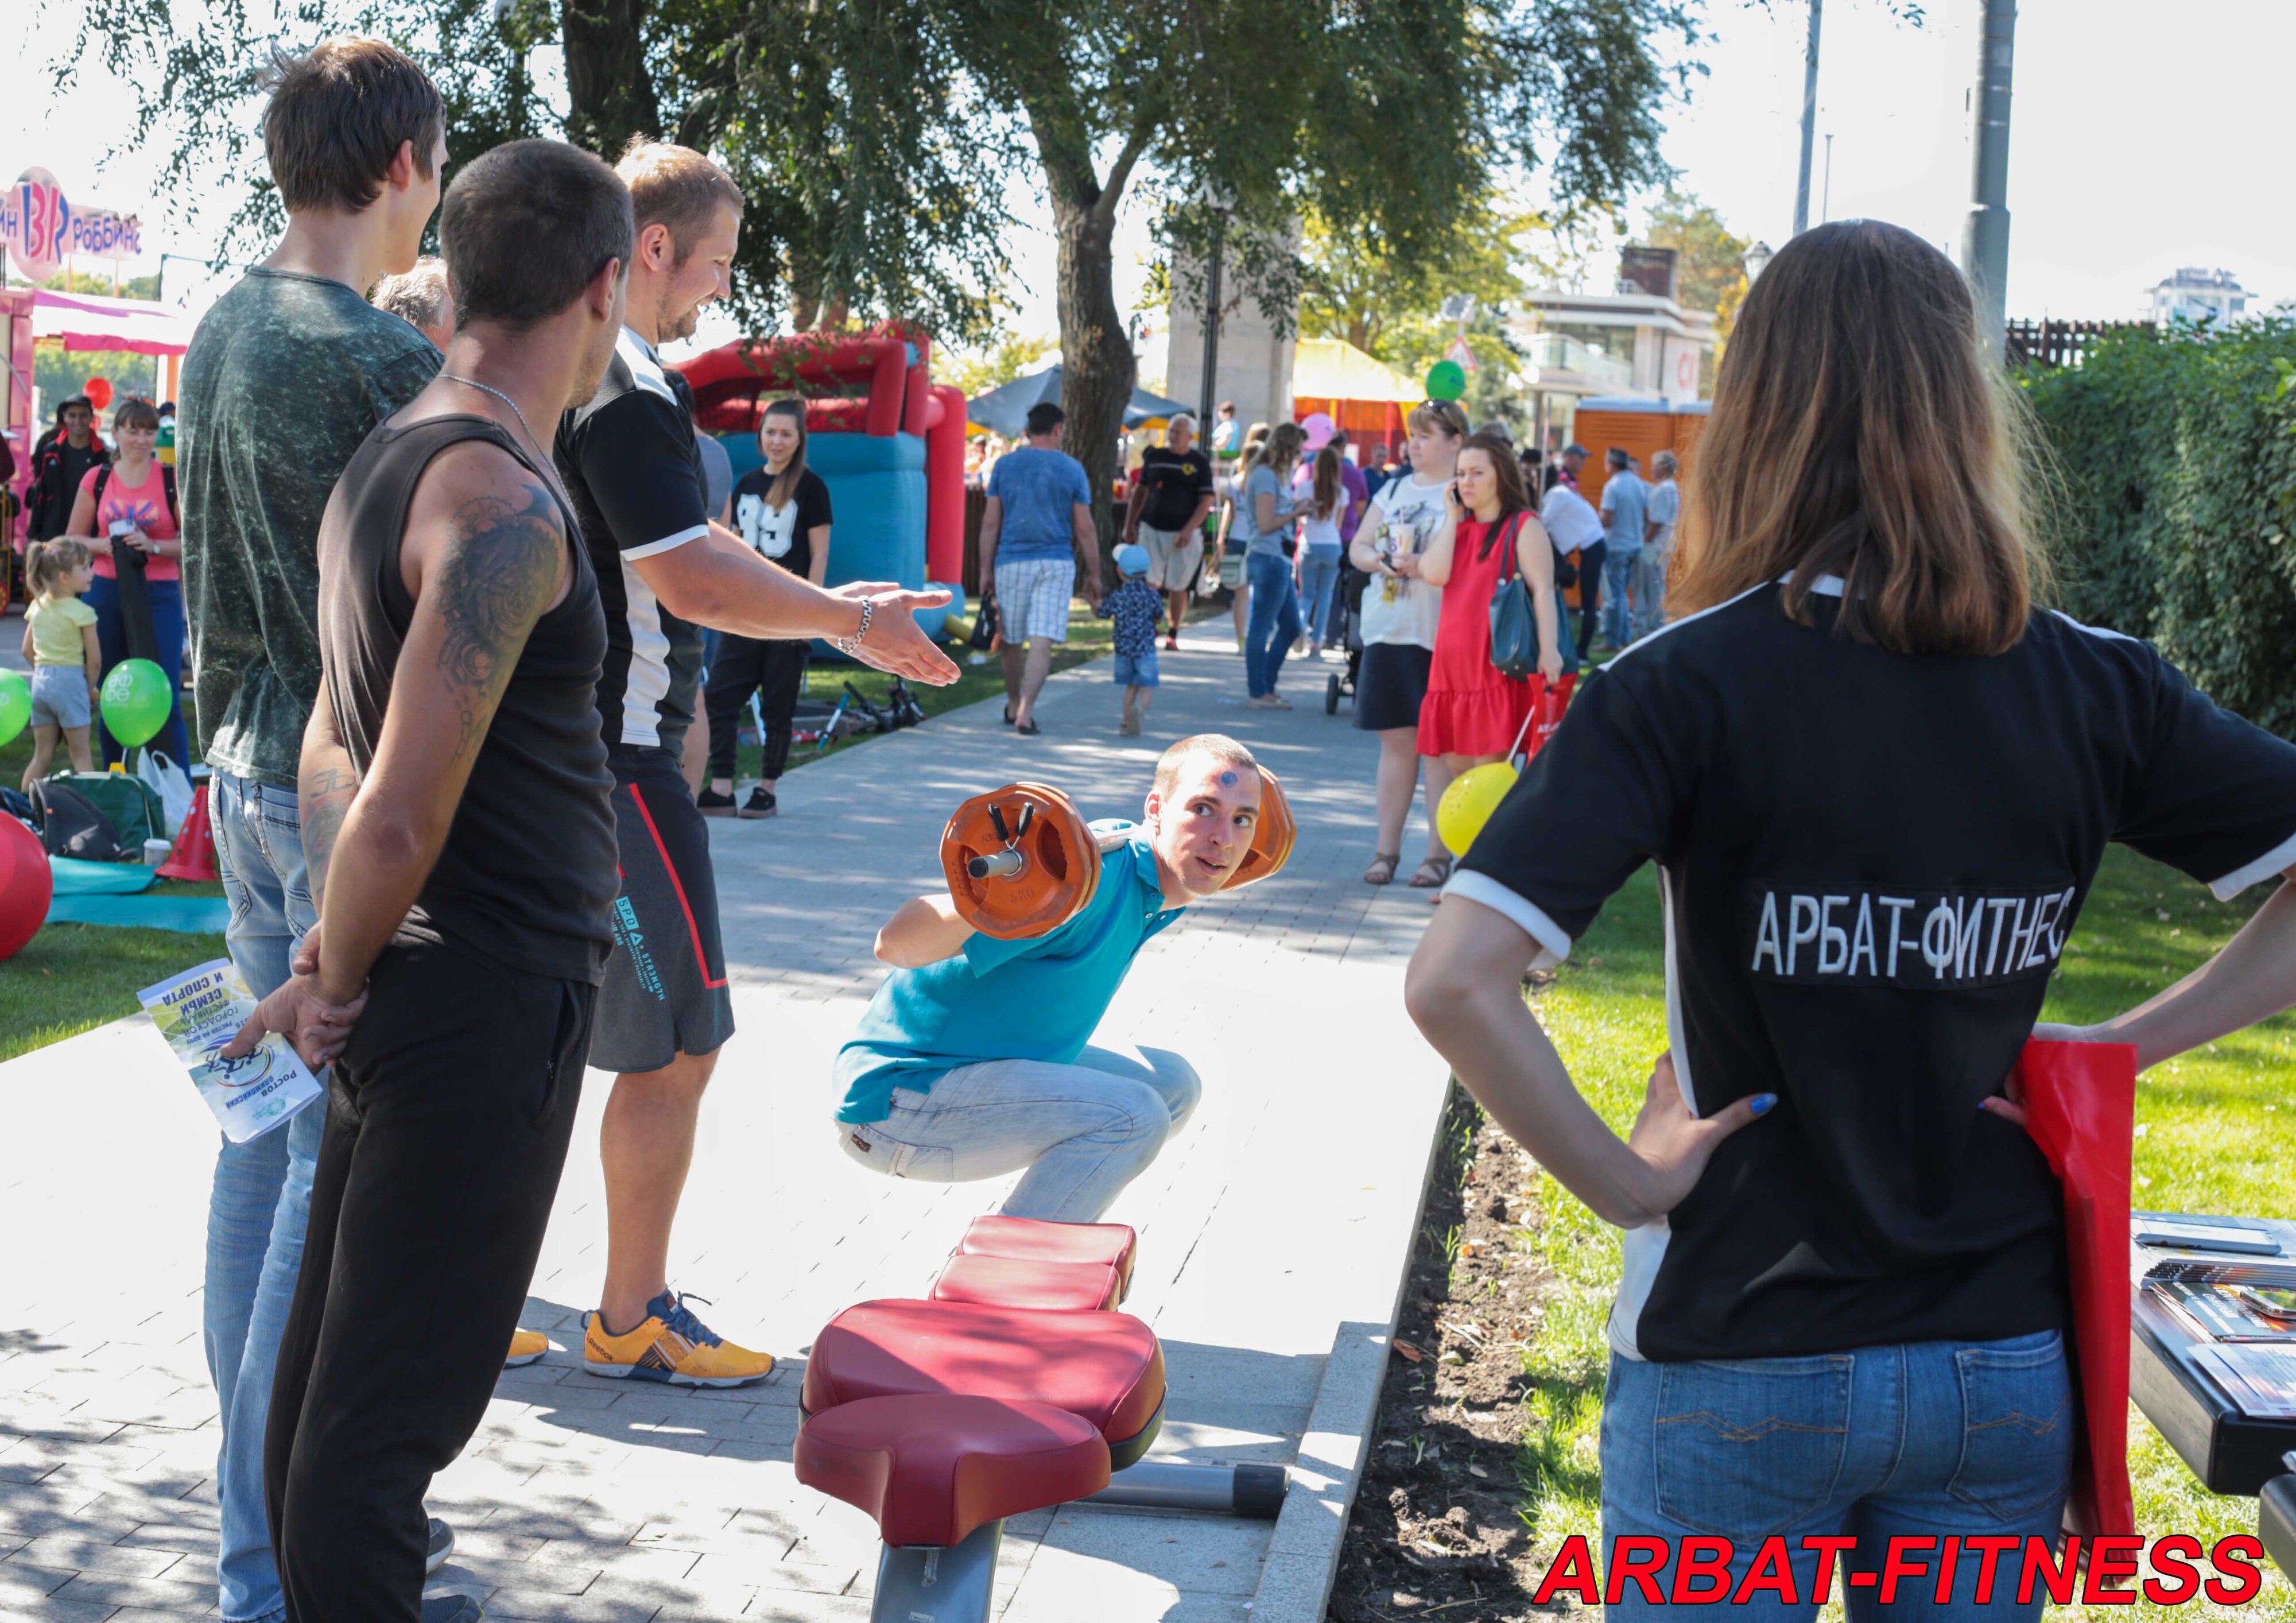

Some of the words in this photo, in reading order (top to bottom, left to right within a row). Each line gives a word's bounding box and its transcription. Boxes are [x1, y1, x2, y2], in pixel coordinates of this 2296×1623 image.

[1752, 886, 2074, 979] АРБАТ-ФИТНЕС
[214, 971, 224, 983] И
[162, 977, 210, 1006] СПОРТА
[180, 988, 222, 1016] СЕМЬИ
[180, 1000, 230, 1025] ФЕСТИВАЛЬ
[184, 1006, 238, 1038] ГОРОДСКОЙ
[588, 1338, 614, 1362] Reebok
